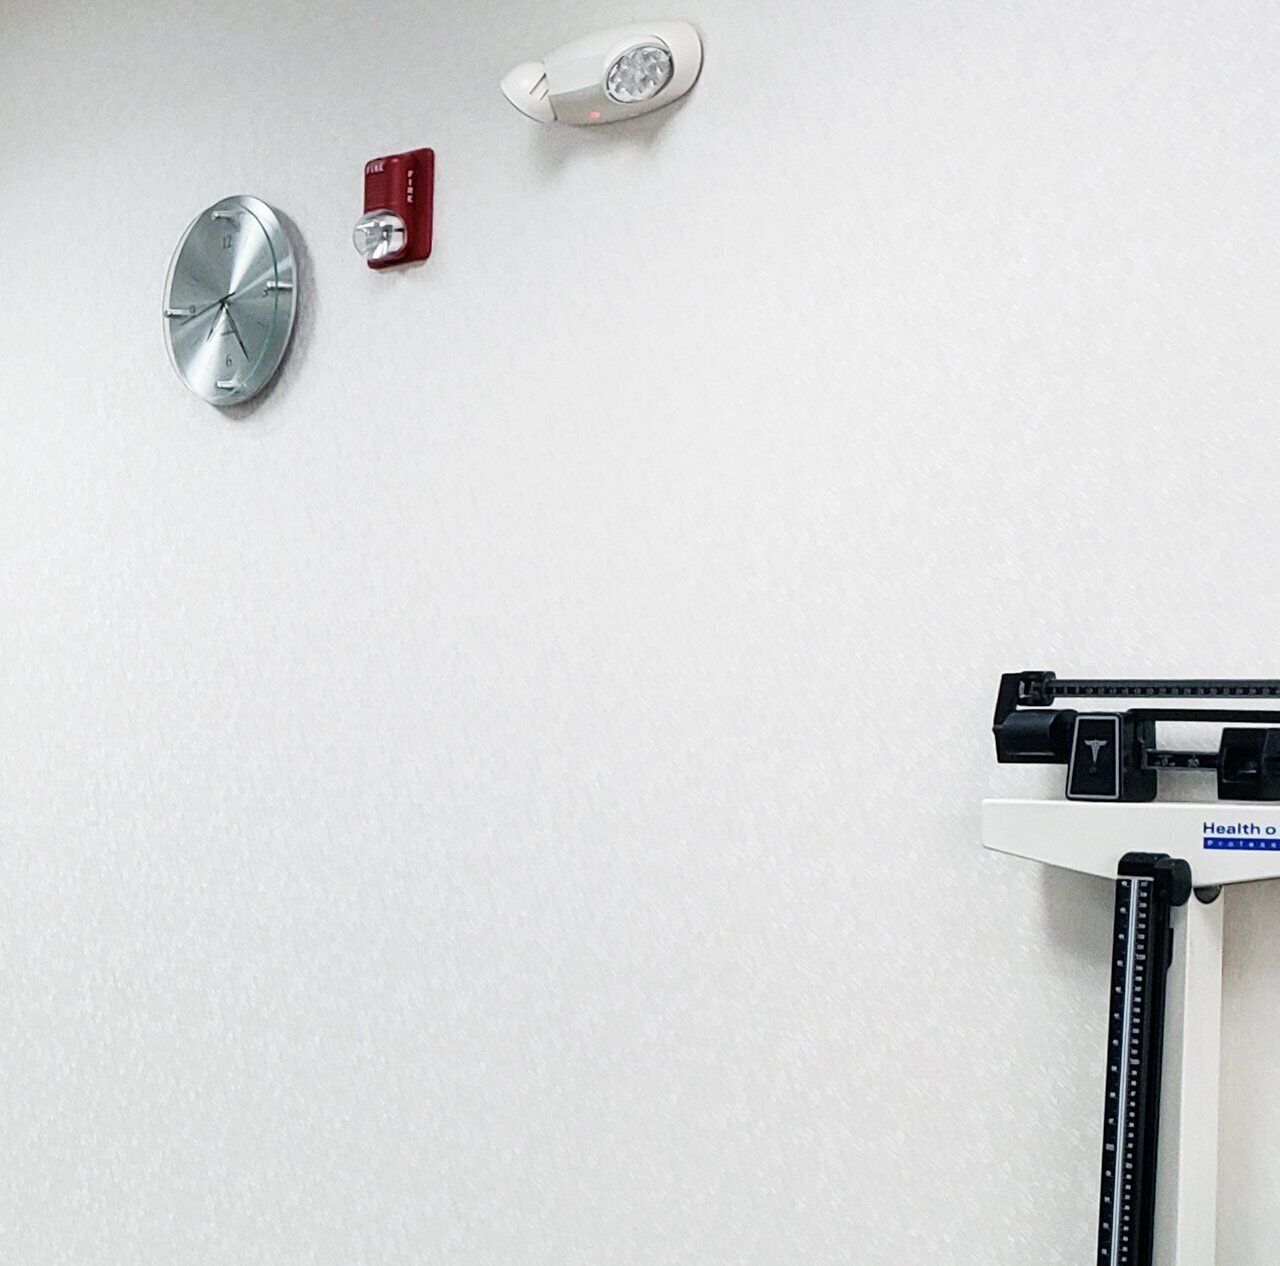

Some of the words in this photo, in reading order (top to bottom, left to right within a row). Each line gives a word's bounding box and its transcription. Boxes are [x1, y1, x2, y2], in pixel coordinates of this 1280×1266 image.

[222, 235, 233, 250] 12
[225, 354, 233, 367] 6
[1203, 822, 1261, 835] Health
[1265, 826, 1277, 836] o
